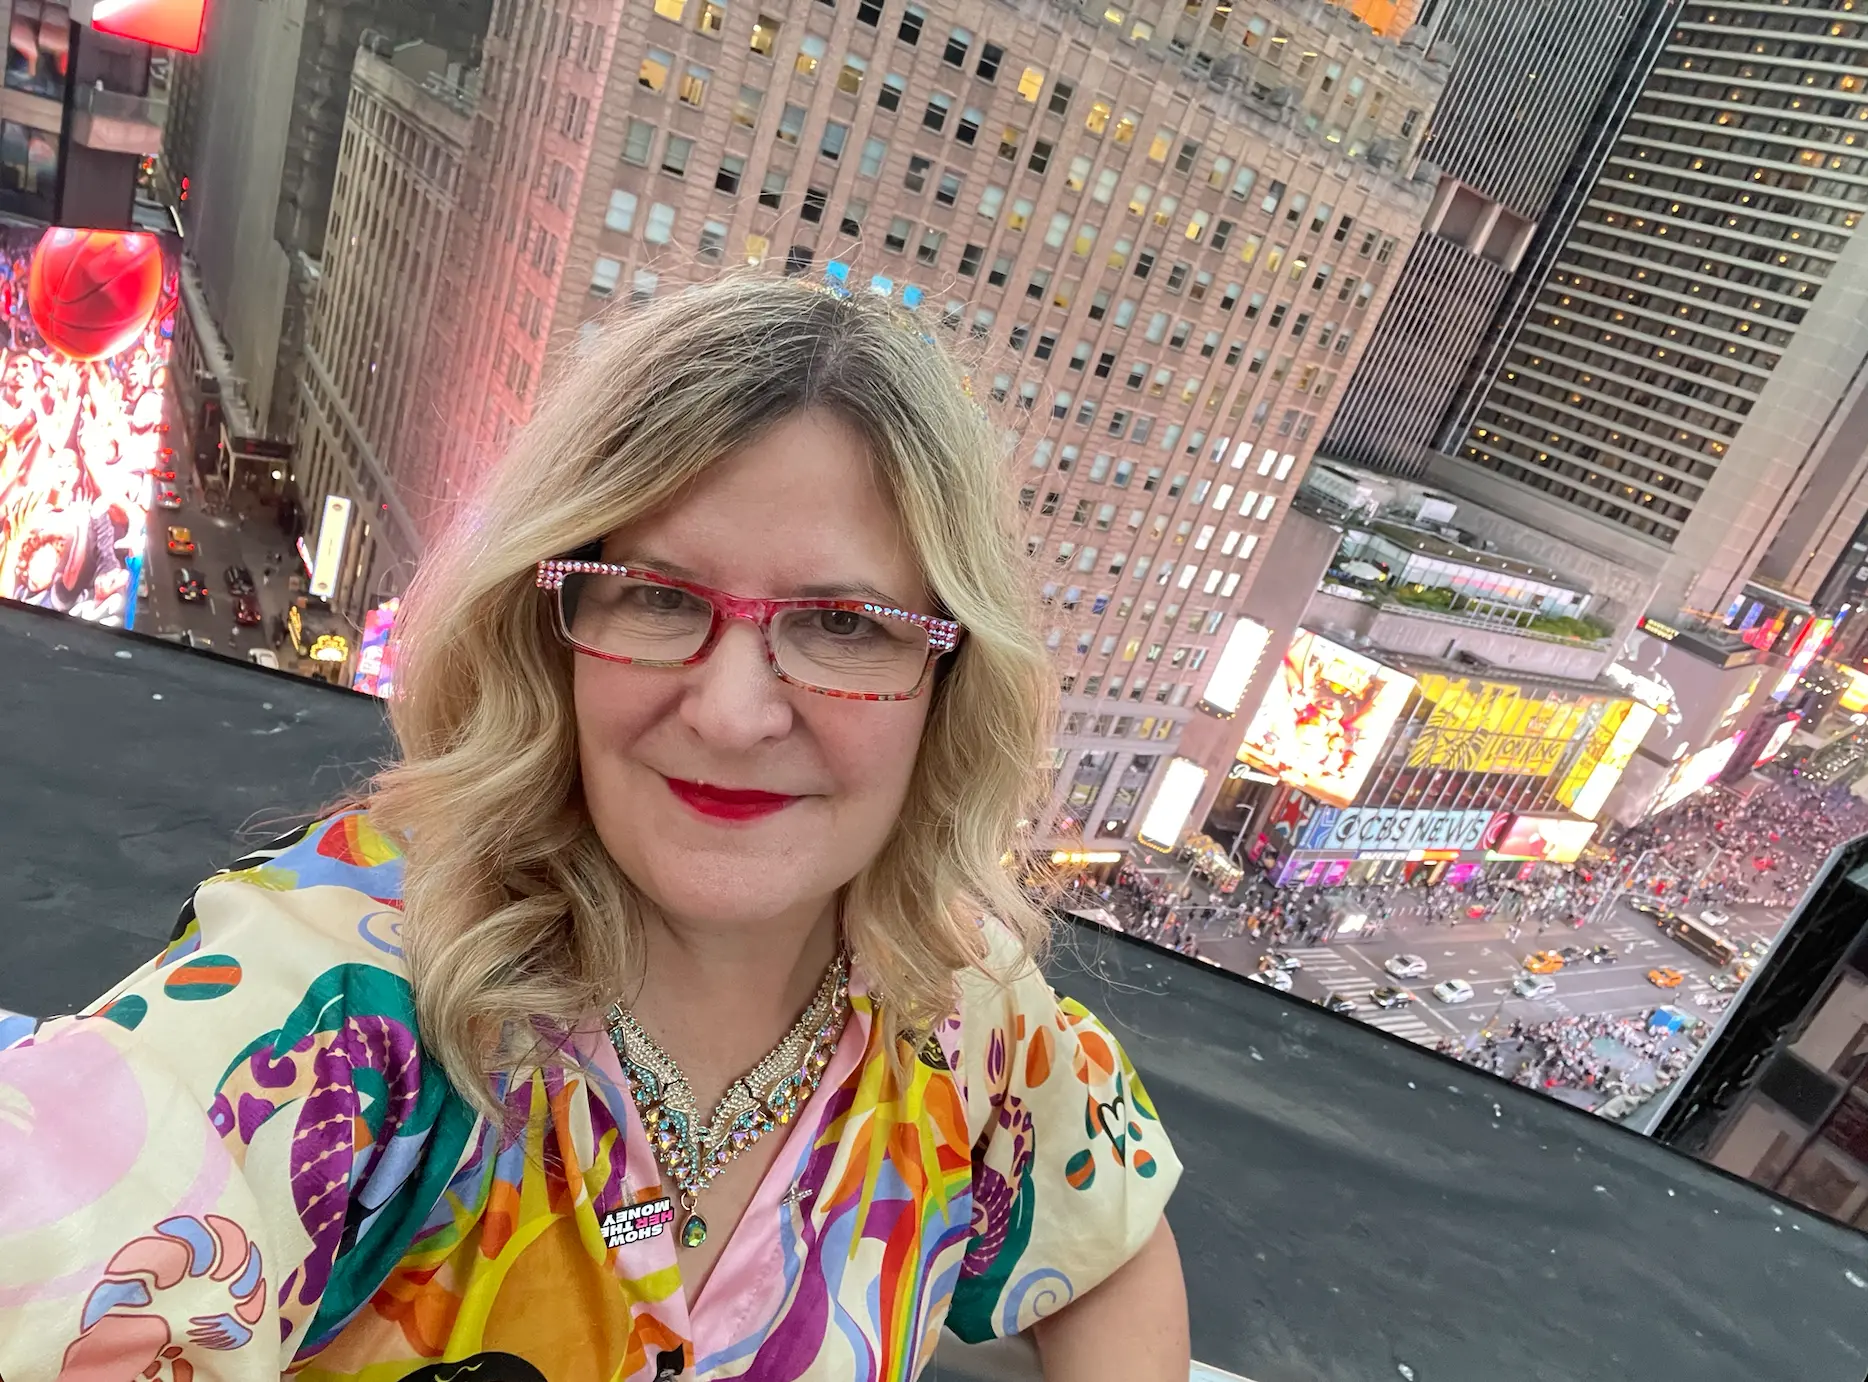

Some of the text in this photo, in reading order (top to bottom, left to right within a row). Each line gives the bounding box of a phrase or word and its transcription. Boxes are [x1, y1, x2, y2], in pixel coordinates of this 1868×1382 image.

[1359, 815, 1484, 843] CBS NEWS
[600, 1210, 674, 1238] HER THE
[602, 1199, 671, 1226] MONEY
[608, 1224, 663, 1248] SHOW
